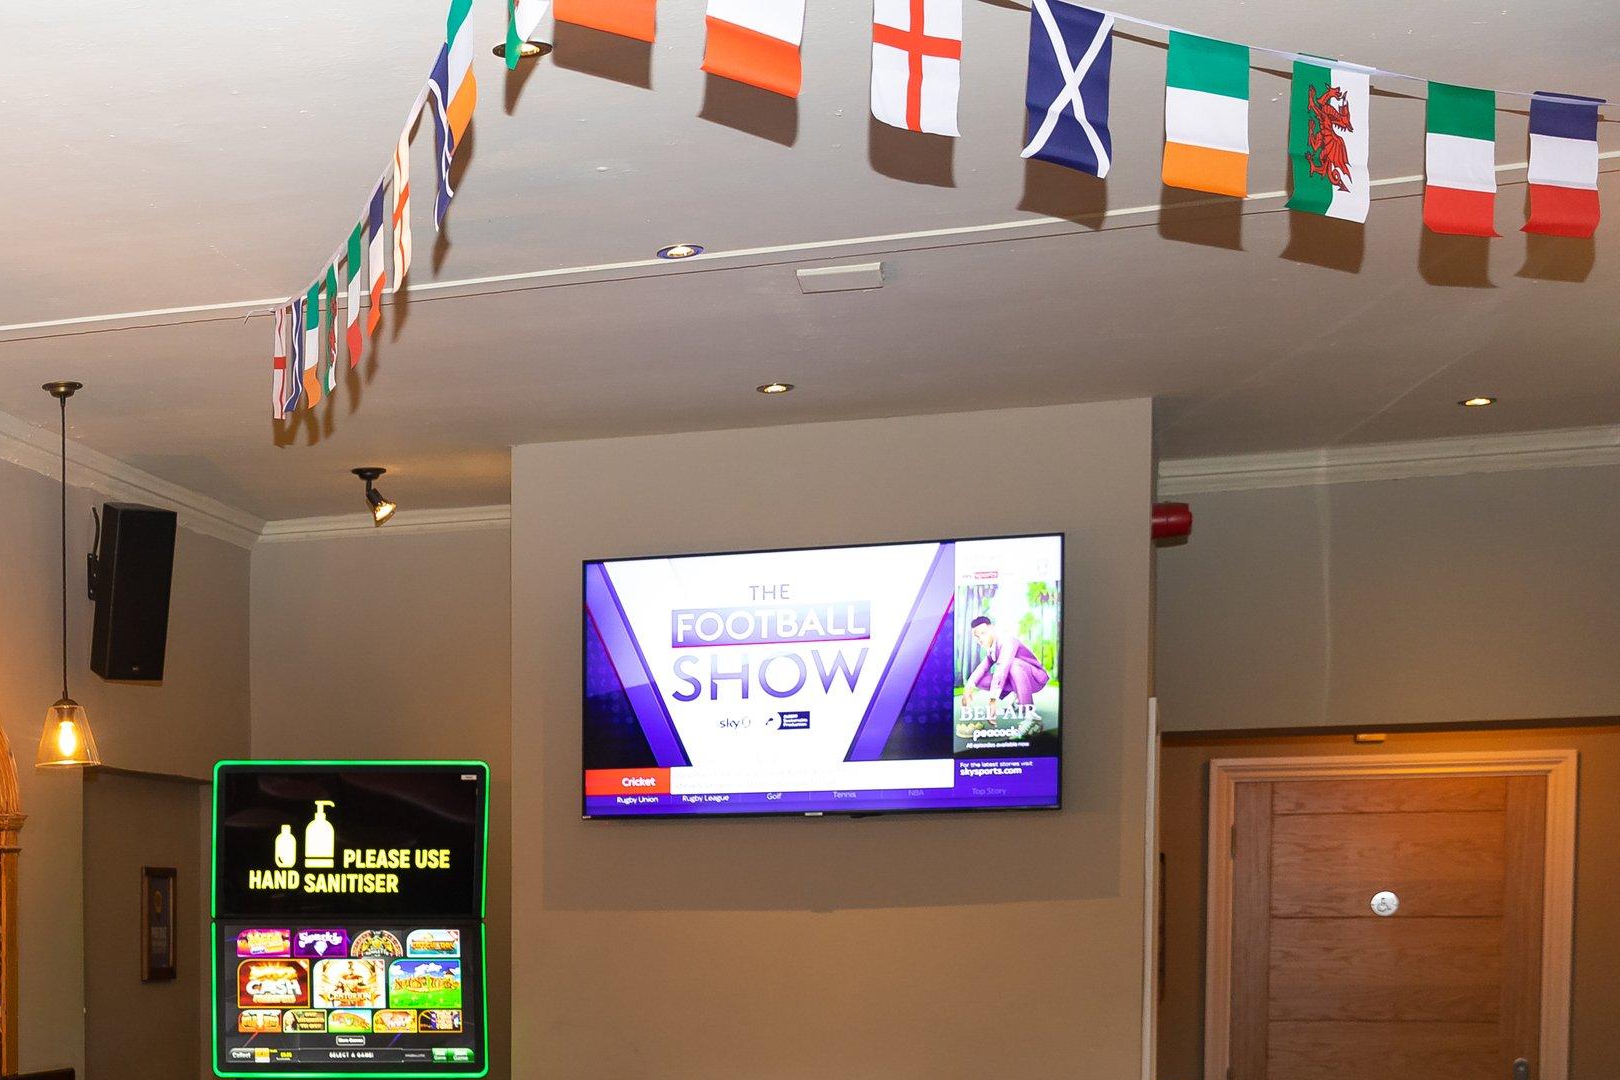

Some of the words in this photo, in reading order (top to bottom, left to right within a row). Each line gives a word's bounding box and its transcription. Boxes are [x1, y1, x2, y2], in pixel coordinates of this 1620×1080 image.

[749, 583, 790, 600] THE
[676, 604, 867, 643] FOOTBALL
[672, 647, 870, 702] SHOW
[719, 717, 741, 730] sky
[960, 761, 970, 769] For
[960, 767, 1023, 777] skysports.com
[621, 776, 657, 787] Cricket
[766, 792, 782, 800] Golf
[833, 791, 857, 799] Tennis
[972, 787, 986, 796] Top
[986, 787, 1007, 796] Story
[616, 796, 638, 805] Rugby
[638, 796, 659, 804] Union
[682, 795, 704, 803] Rugby
[704, 794, 730, 803] League
[343, 848, 411, 869] PLEASE
[414, 848, 451, 869] USE
[248, 869, 300, 890] HAND
[303, 873, 399, 893] SANITISER
[328, 1051, 350, 1059] SELECT
